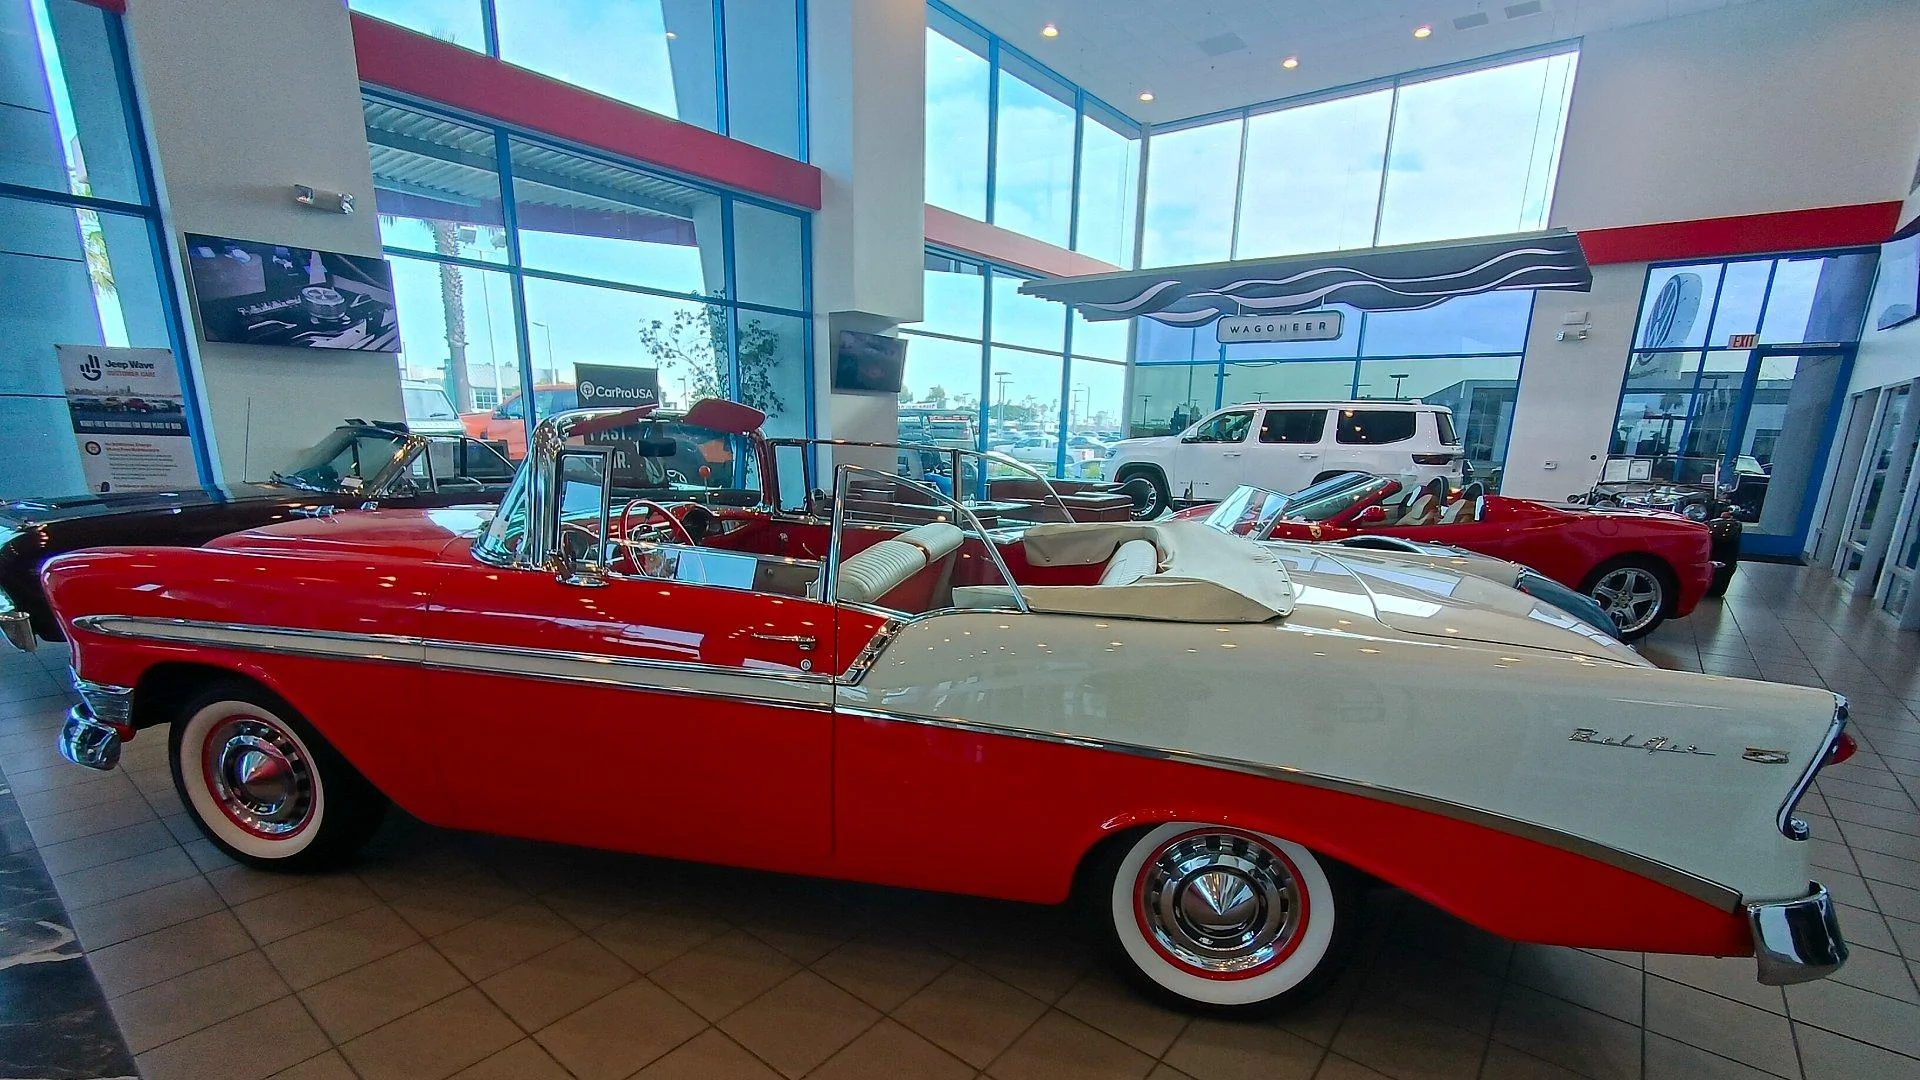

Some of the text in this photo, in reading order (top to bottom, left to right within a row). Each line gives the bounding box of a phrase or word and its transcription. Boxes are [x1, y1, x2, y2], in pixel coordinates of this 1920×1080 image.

[1229, 321, 1327, 334] WAGONEER
[1732, 335, 1755, 348] EXIT
[105, 359, 154, 370] Jeep Wave
[595, 385, 654, 399] CarProUSA
